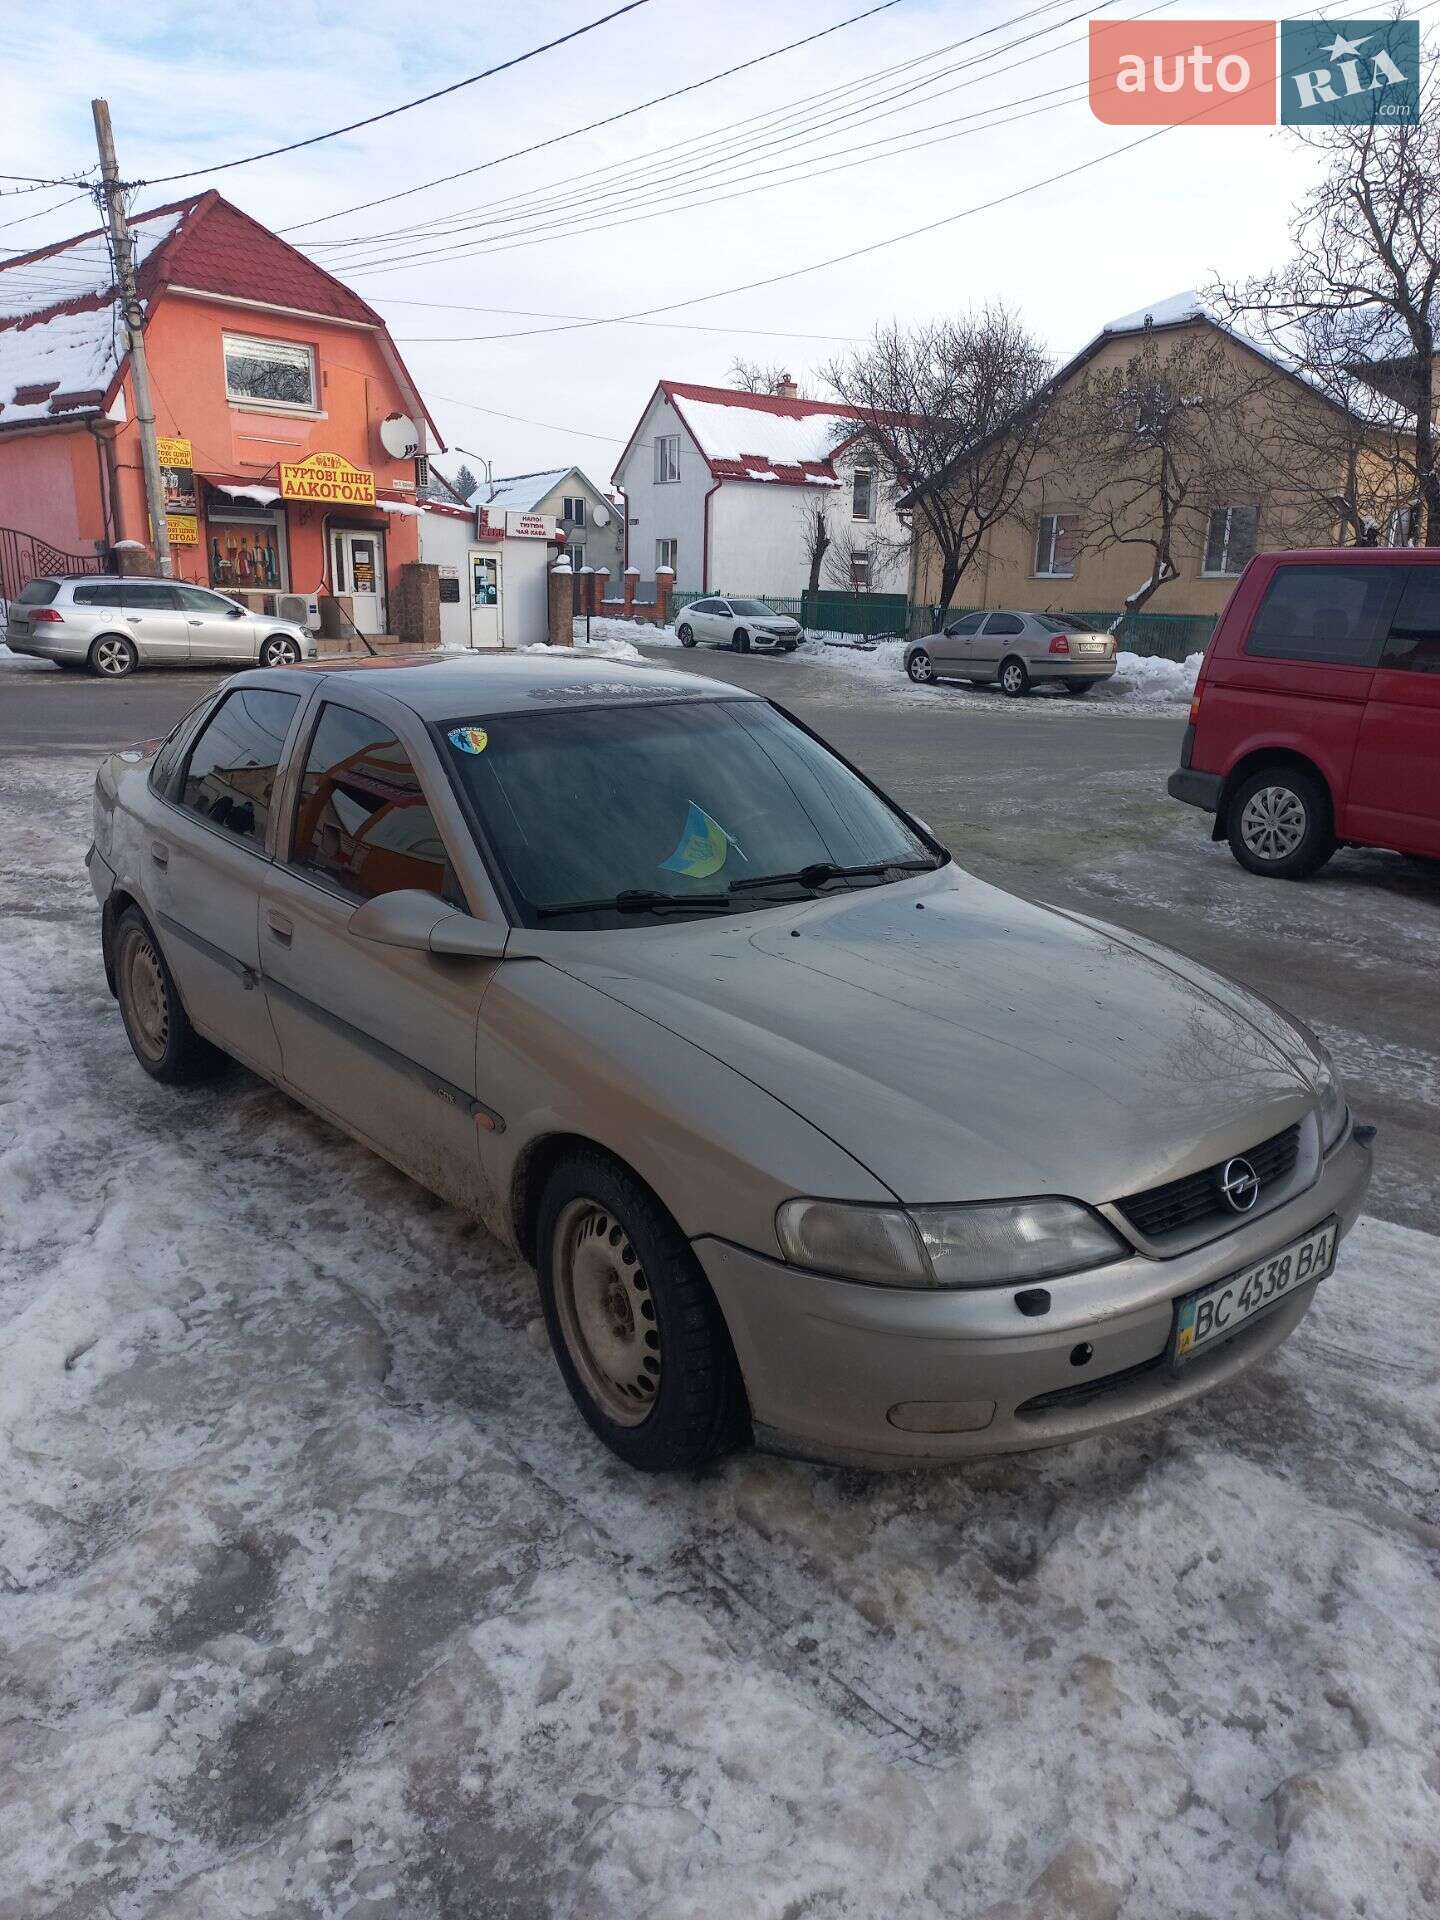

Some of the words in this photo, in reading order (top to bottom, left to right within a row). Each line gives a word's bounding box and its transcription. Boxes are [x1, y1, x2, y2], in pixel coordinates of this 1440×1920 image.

[283, 466, 338, 482] ГУРТОВІ
[340, 471, 372, 485] ЦІНИ
[284, 480, 373, 501] АЛКОГОЛЬ
[1194, 1289, 1234, 1342] BC
[1237, 1255, 1291, 1312] 4538
[1294, 1235, 1328, 1282] BA
